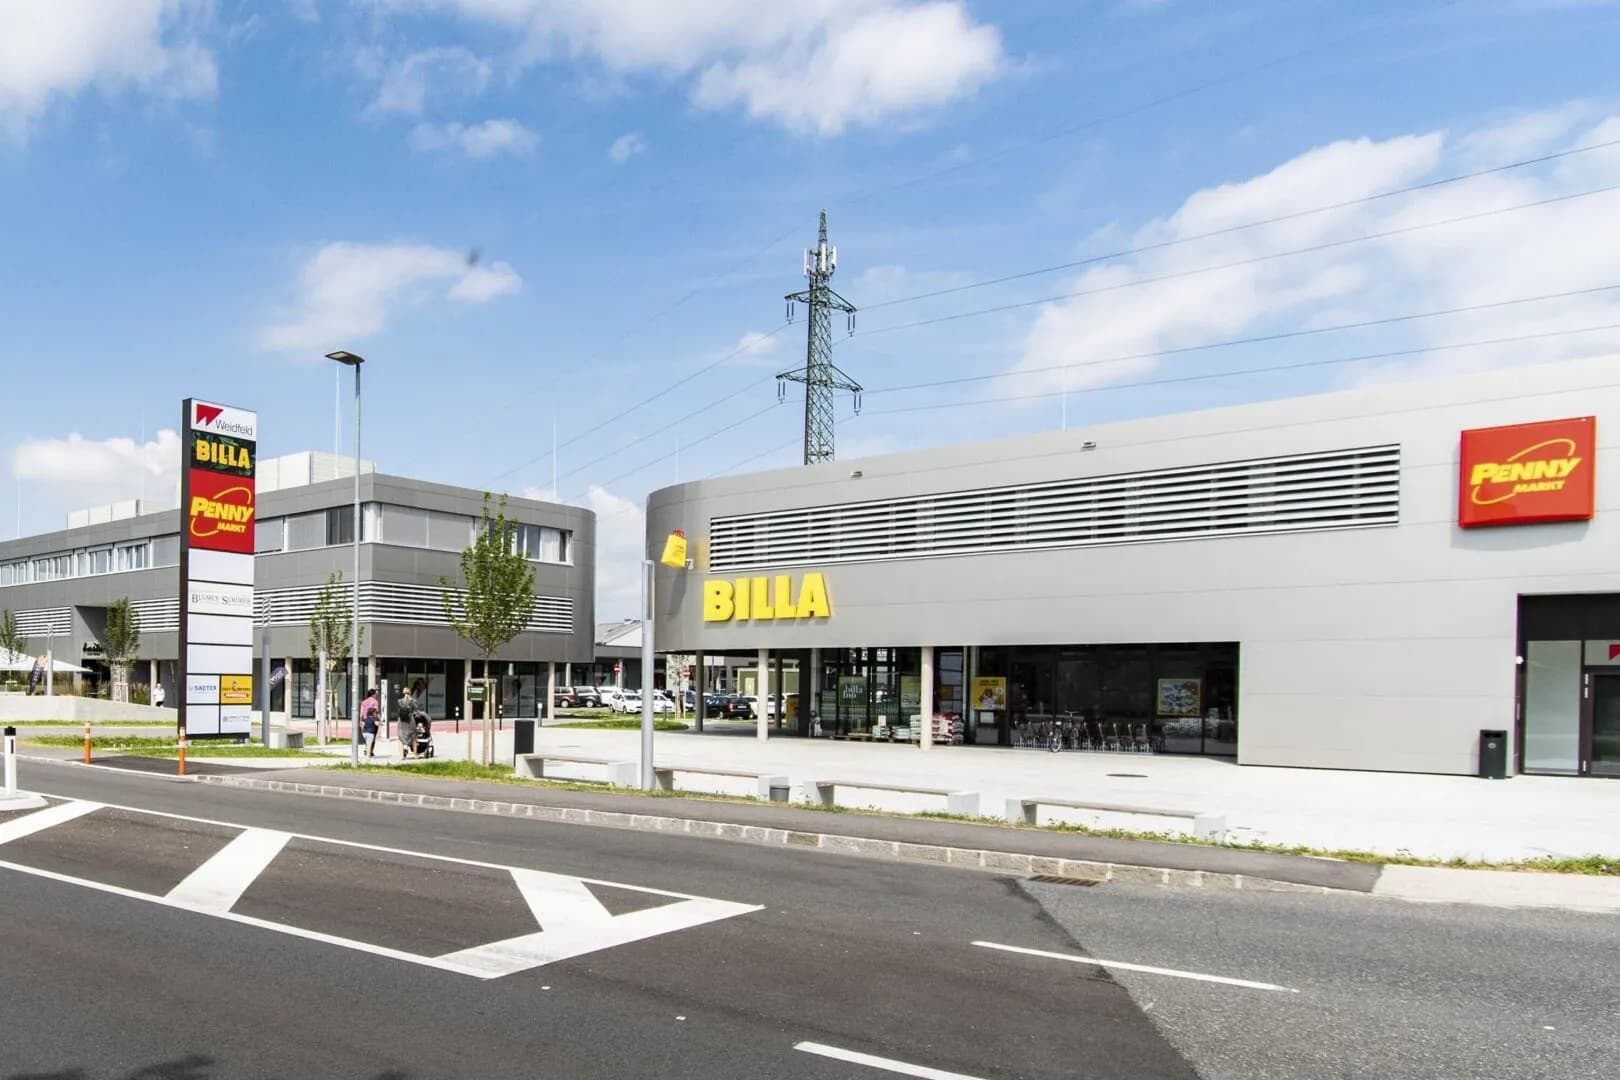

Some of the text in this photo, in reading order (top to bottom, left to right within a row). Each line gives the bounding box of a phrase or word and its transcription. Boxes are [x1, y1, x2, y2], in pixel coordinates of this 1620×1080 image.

[216, 419, 253, 436] Weidfeld
[196, 439, 252, 470] BILLA
[1470, 457, 1582, 486] PENNY
[1513, 480, 1566, 493] MARKT
[190, 496, 254, 523] PENNY
[217, 522, 247, 533] MARKT
[703, 572, 831, 622] BILLA
